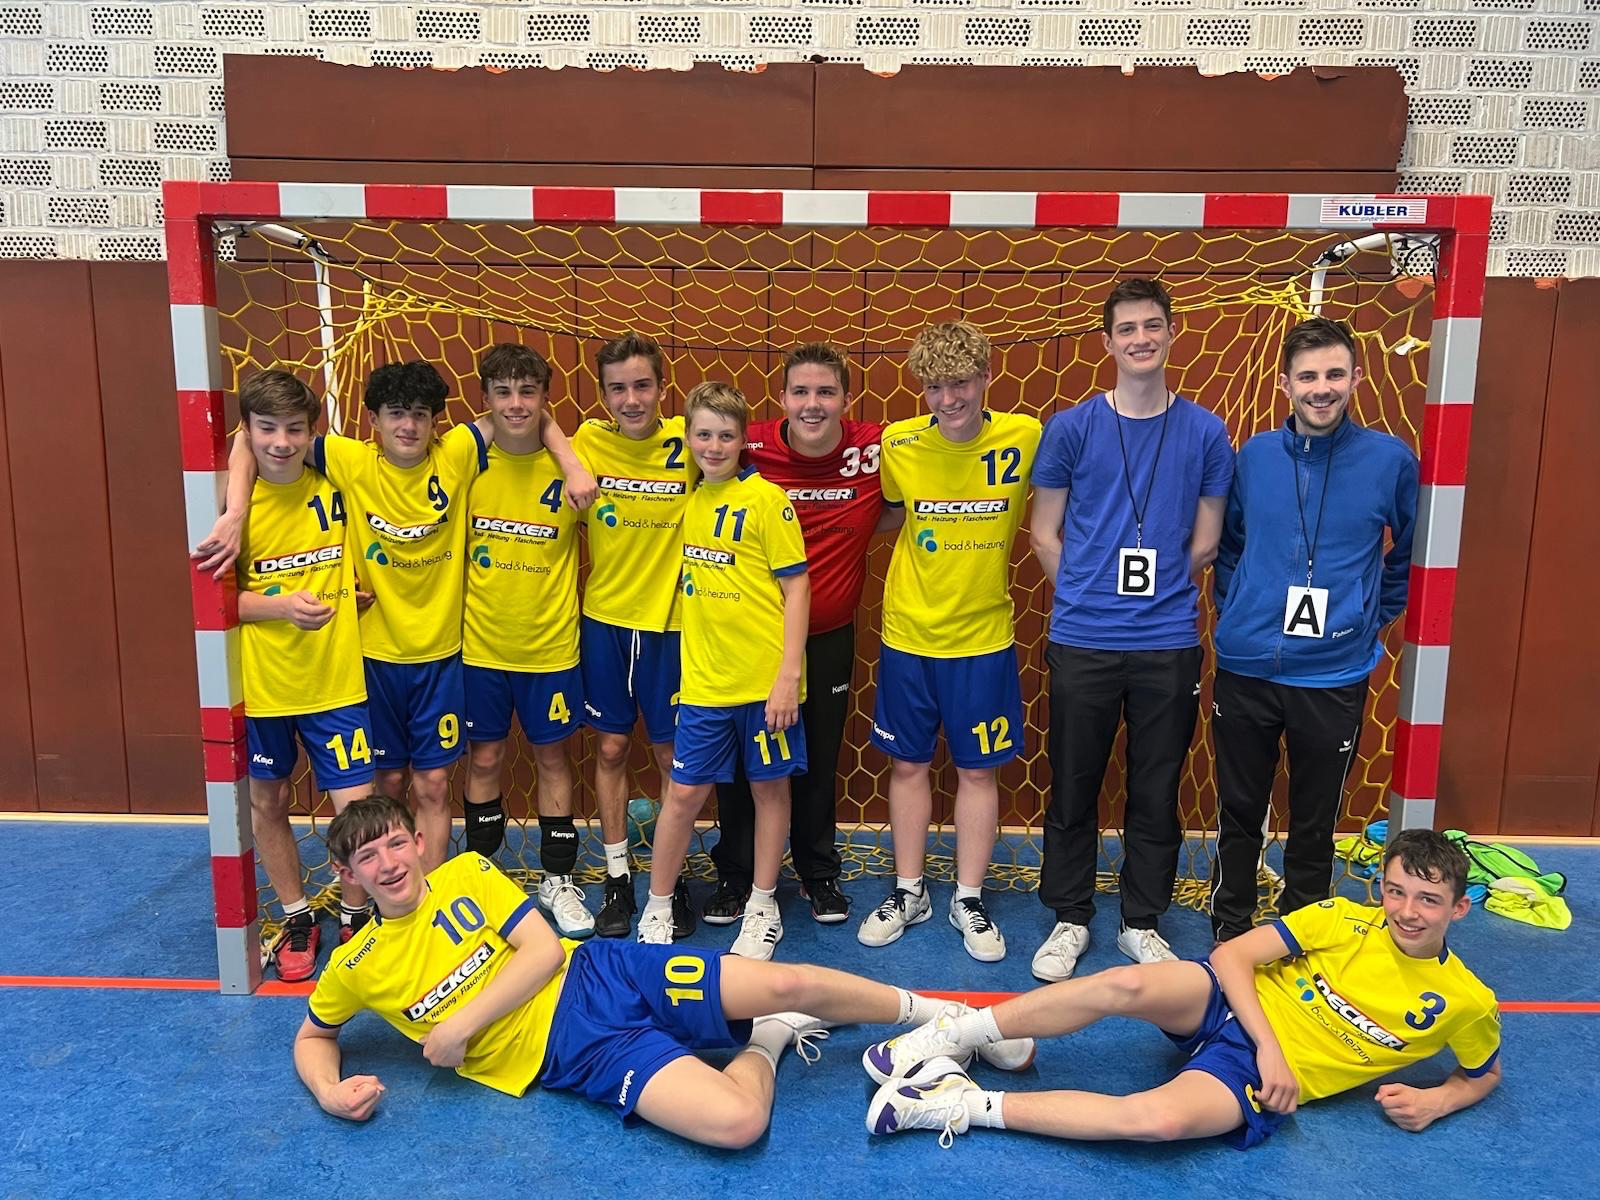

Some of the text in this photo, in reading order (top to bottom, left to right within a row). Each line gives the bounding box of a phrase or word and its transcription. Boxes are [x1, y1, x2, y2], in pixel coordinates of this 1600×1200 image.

[1339, 203, 1408, 216] KÜBLER
[662, 437, 685, 469] 2
[746, 442, 763, 450] mpa
[891, 435, 919, 448] Kempa
[839, 444, 881, 477] 33
[980, 447, 1021, 485] 12
[428, 475, 449, 511] 9
[540, 478, 564, 513] 4
[600, 476, 680, 494] DECKER
[613, 493, 636, 501] Heizung
[785, 488, 852, 500] ECKER
[307, 491, 347, 532] 14
[918, 500, 1004, 513] DECKER
[370, 514, 439, 538] DECK
[474, 517, 554, 538] DECKER
[623, 517, 641, 528] bad
[713, 503, 748, 542] 11
[260, 545, 343, 573] DECKER
[685, 545, 729, 564] ECKER
[944, 540, 1005, 550] bad & heizung
[311, 562, 342, 574] Flaschnere
[392, 557, 411, 568] bad
[495, 558, 513, 570] bad
[522, 560, 551, 575] heizung
[1121, 554, 1151, 593] B
[322, 588, 349, 600] heig
[708, 588, 740, 602] heizung
[1285, 594, 1321, 635] A
[832, 683, 849, 694] Kemp
[548, 692, 571, 724] 4
[584, 700, 602, 718] empa
[438, 713, 460, 749] 9
[971, 716, 1013, 755] 12
[326, 728, 372, 770] 14
[753, 729, 791, 765] 11
[479, 813, 502, 823] Kempa
[551, 830, 575, 839] Kempa
[432, 896, 486, 946] 10
[345, 937, 376, 969] Kempa
[408, 944, 489, 1020] DECKER
[663, 955, 706, 1007] 10
[430, 995, 457, 1020] Heizung
[1315, 978, 1404, 1049] DECKER
[1404, 990, 1447, 1030] 3
[1340, 1032, 1374, 1064] heizun
[618, 1069, 635, 1106] Kempa
